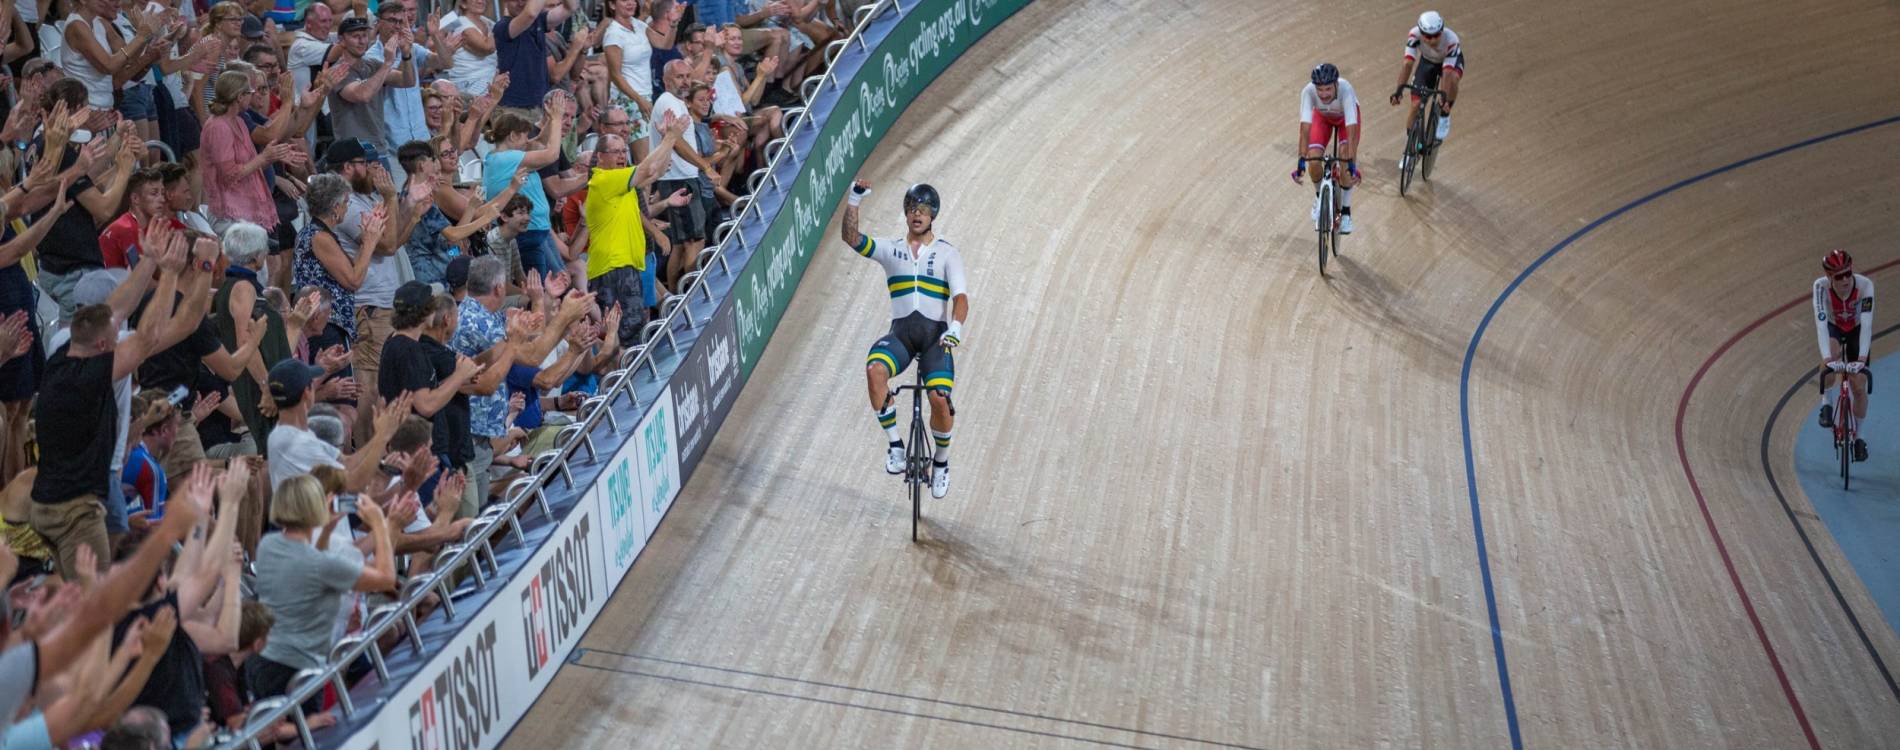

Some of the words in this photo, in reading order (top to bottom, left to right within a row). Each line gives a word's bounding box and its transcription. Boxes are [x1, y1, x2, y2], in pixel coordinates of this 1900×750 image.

[909, 0, 966, 75] cycling.org.au
[675, 381, 700, 439] brisbane
[540, 512, 594, 653] TISSOT
[434, 620, 500, 750] TISSOT
